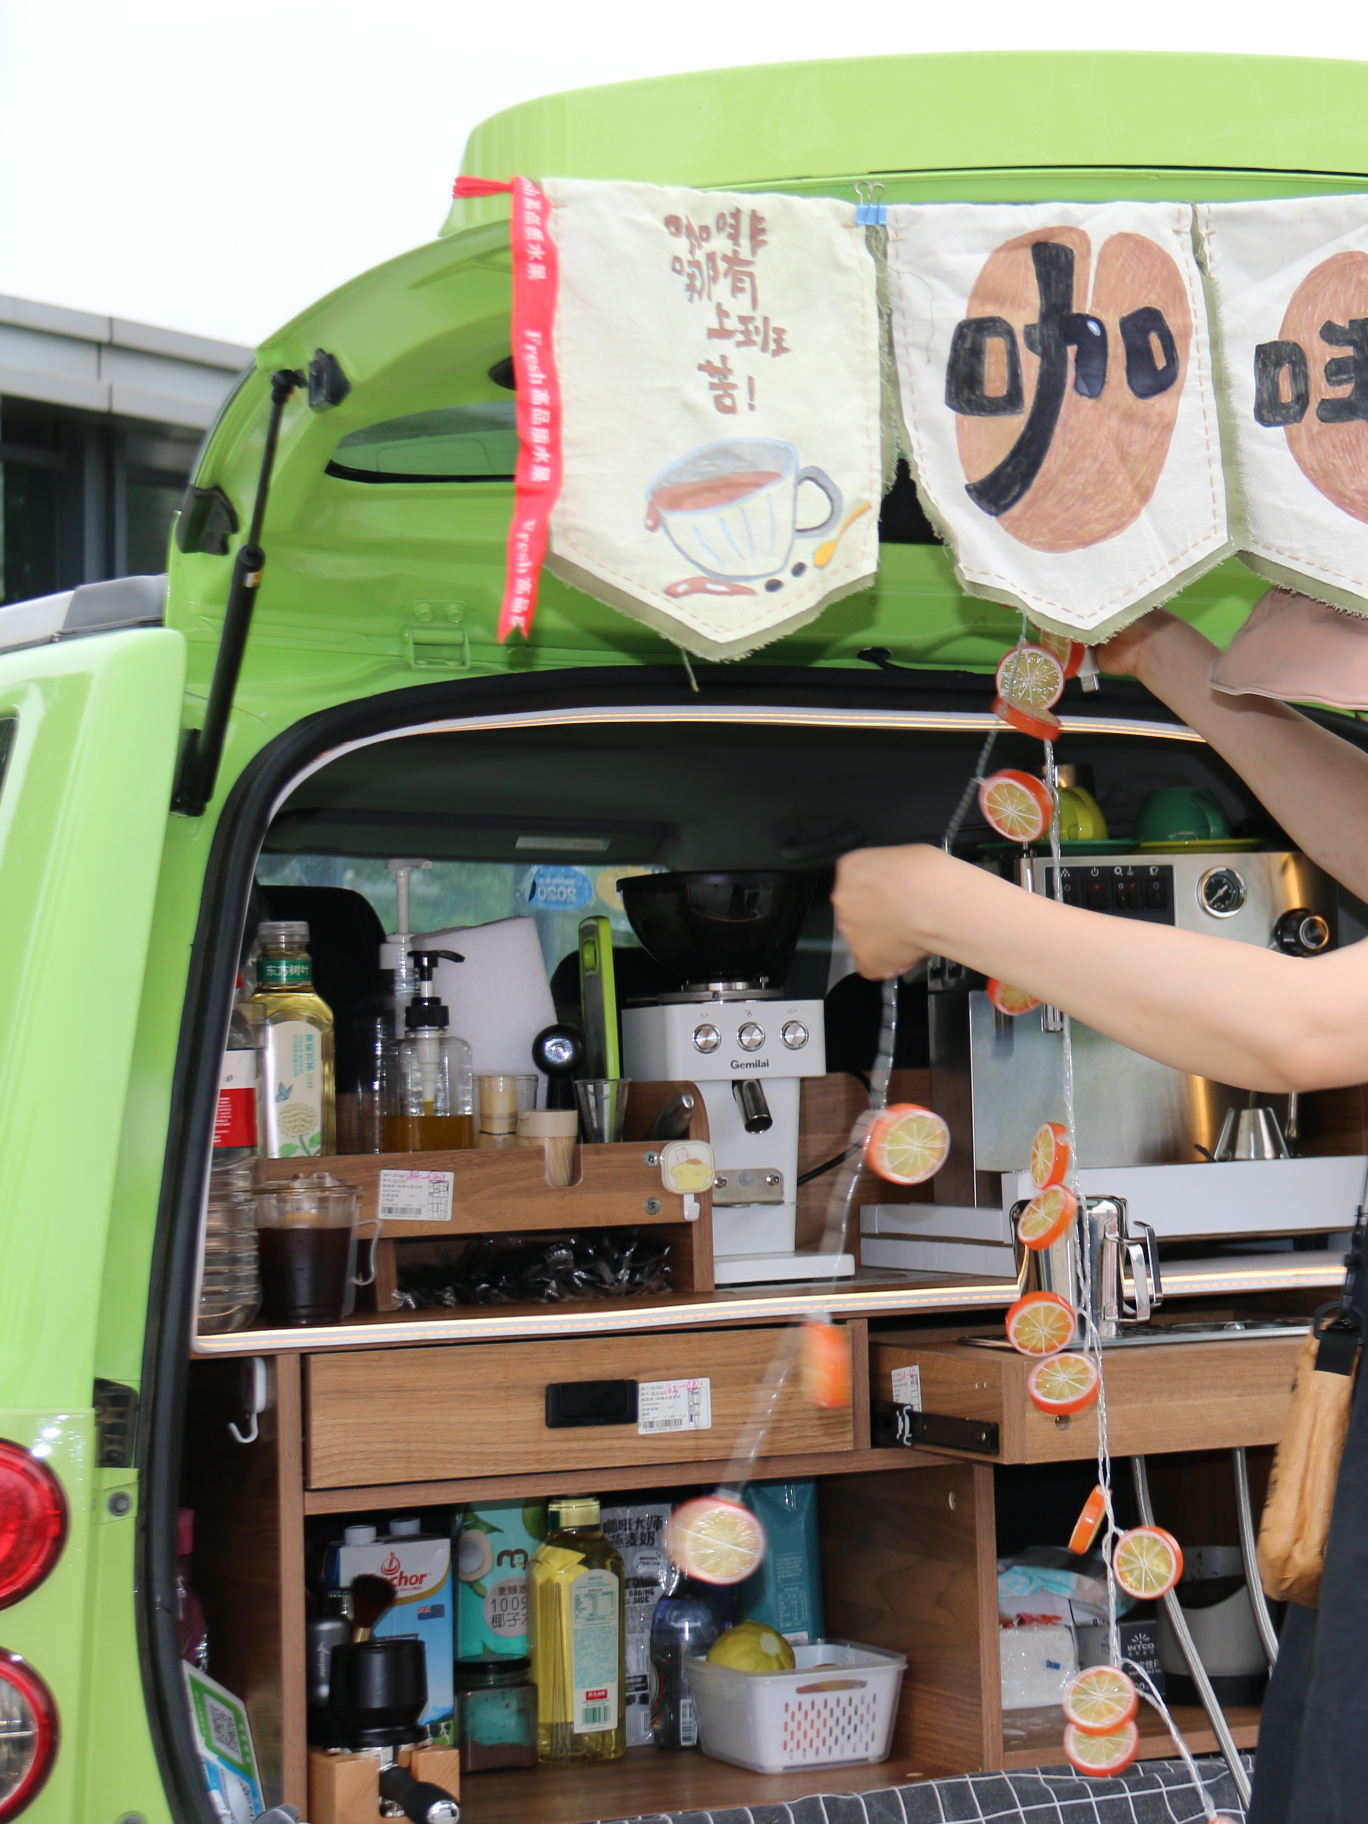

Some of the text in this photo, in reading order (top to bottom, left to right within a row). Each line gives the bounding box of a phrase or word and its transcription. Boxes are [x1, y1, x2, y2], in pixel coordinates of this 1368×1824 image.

[666, 208, 769, 252] 咖啡
[705, 304, 792, 359] 上班
[945, 241, 1179, 518] 咖
[265, 963, 310, 979] 东方树叶
[729, 1058, 770, 1070] Gemilai
[601, 1513, 664, 1535] 咖啡大师
[1127, 1642, 1155, 1652] INTCO
